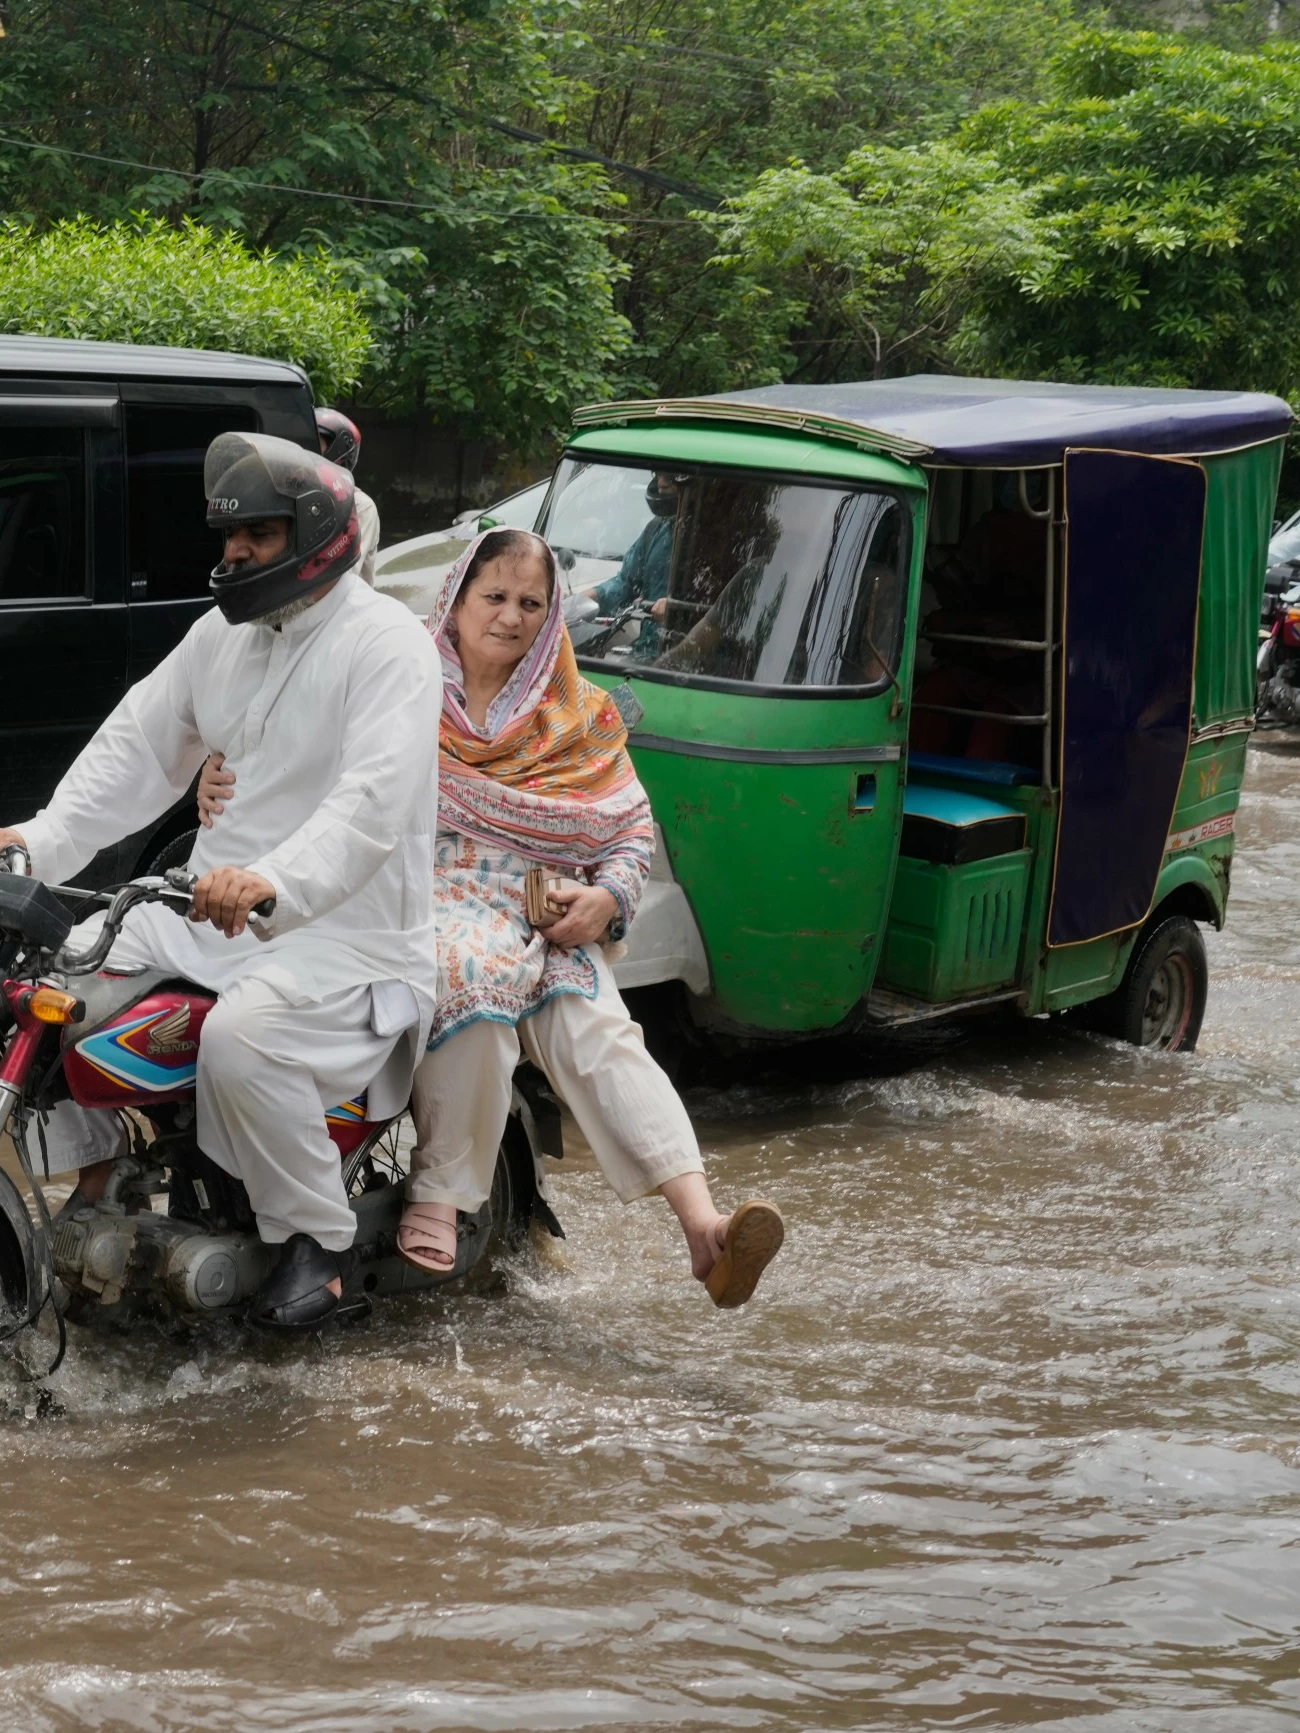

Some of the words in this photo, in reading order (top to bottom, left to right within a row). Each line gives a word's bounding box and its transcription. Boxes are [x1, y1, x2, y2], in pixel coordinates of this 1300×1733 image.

[327, 535, 348, 558] VITRO
[1201, 817, 1233, 837] RACER
[147, 1040, 198, 1055] HONDA
